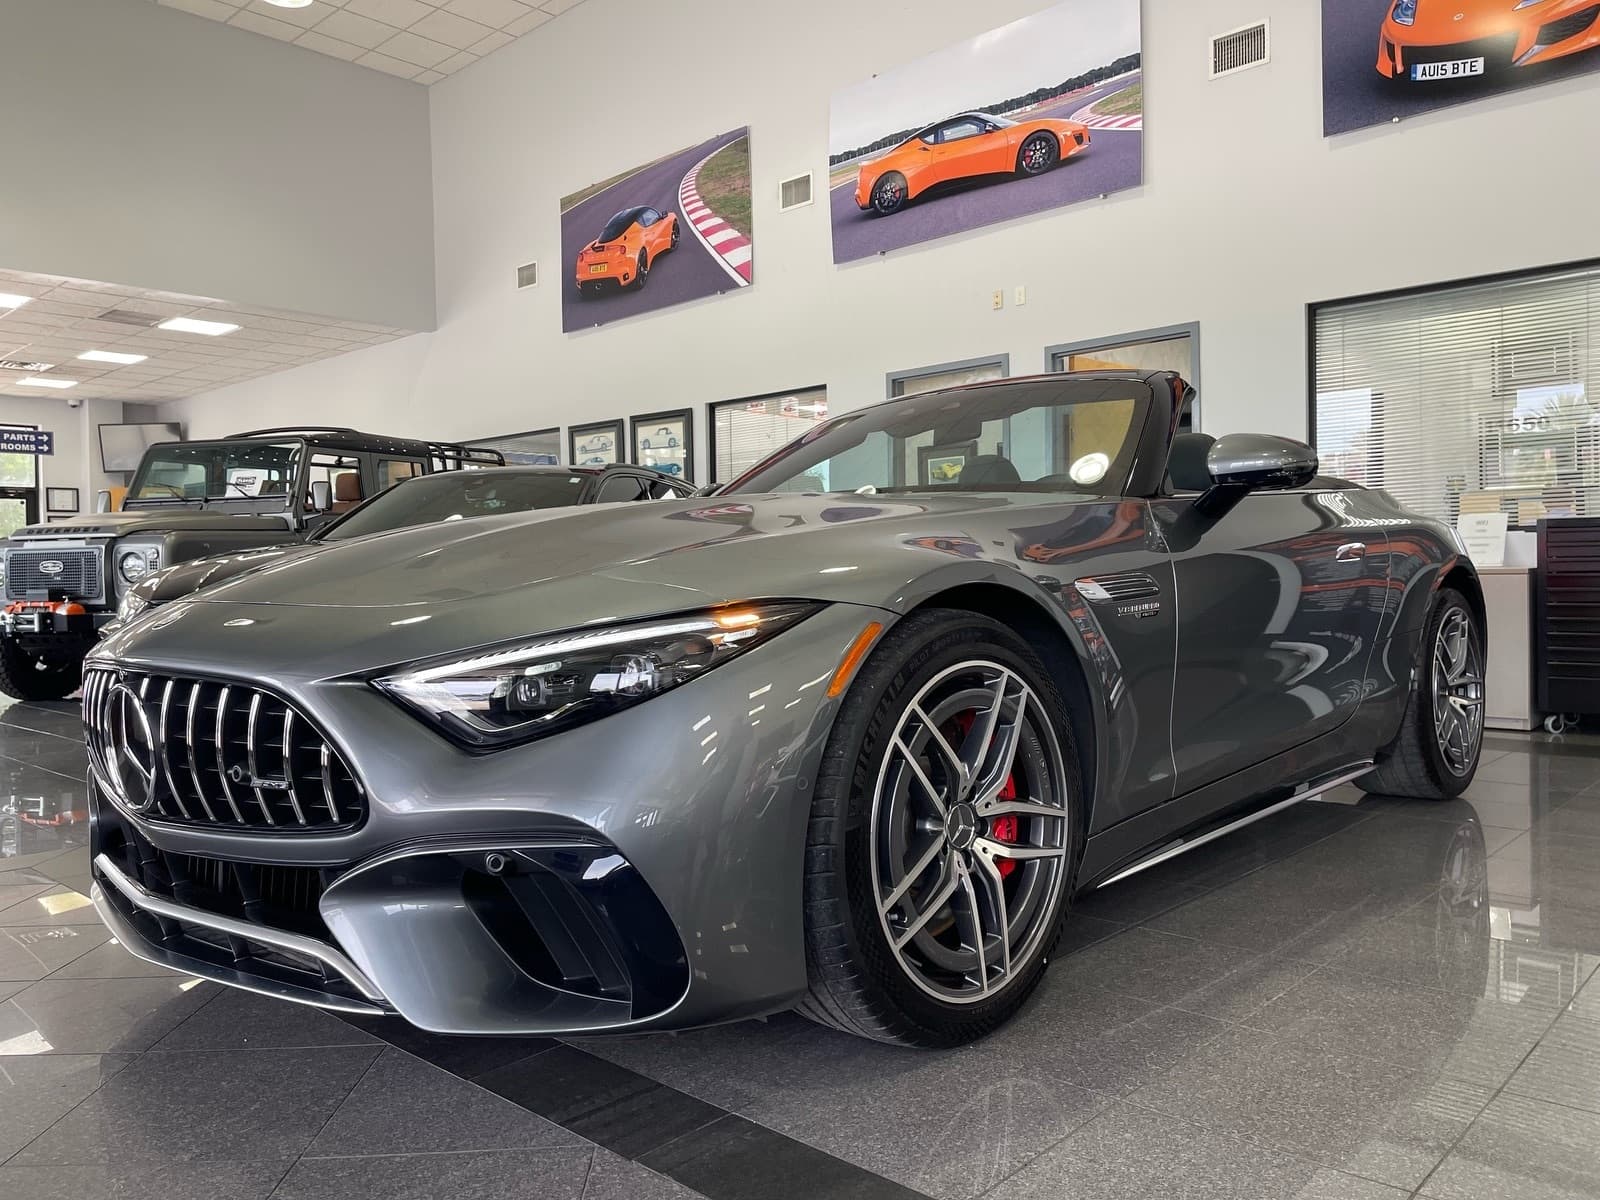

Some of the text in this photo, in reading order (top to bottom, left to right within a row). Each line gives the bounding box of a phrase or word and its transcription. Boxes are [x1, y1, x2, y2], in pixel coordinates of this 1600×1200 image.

[1420, 60, 1479, 78] AU15 BTE
[3, 433, 36, 442] PARTS
[0, 442, 36, 451] ROOMS
[26, 527, 101, 536] DEFENDER
[854, 671, 907, 789] MICHELIN
